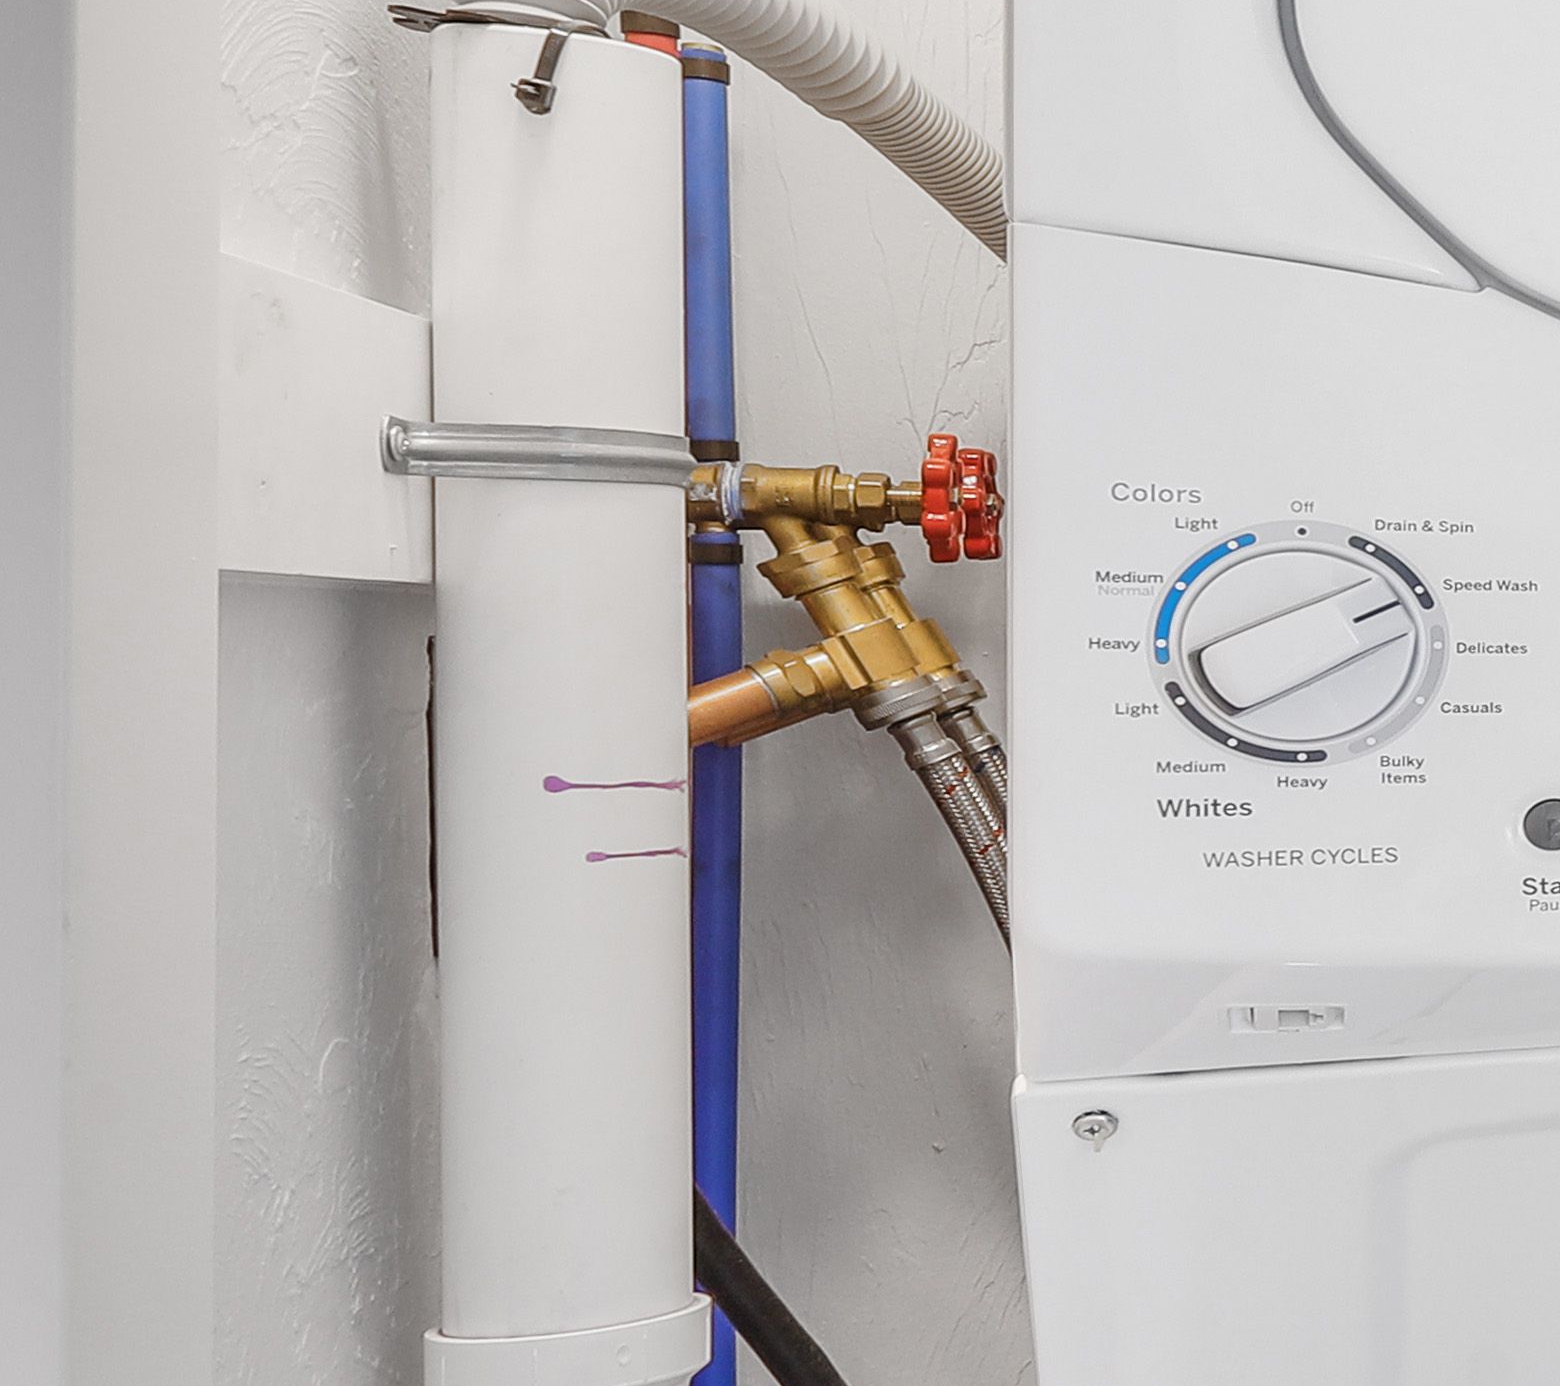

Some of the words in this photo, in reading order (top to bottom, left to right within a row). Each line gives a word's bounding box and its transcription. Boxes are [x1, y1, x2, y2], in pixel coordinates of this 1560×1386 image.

[1111, 482, 1202, 504] Colors
[1290, 501, 1315, 513] Off
[1174, 516, 1218, 533] Light
[1374, 519, 1416, 533] Drain
[1422, 521, 1433, 533] &
[1439, 521, 1474, 535] Spin
[1095, 571, 1164, 584] Medium
[1098, 586, 1155, 597] Normal
[1443, 579, 1493, 594] Speed
[1496, 580, 1538, 593] Wash
[1088, 638, 1140, 653] Heavy
[1456, 642, 1528, 656] Delicates
[1115, 703, 1159, 718] Light
[1440, 702, 1503, 714] Casuals
[1156, 760, 1226, 774] Medium
[1380, 756, 1425, 771] Bulky
[1277, 776, 1328, 791] Heavy
[1381, 772, 1426, 785] Items
[1157, 798, 1253, 818] Whites
[1203, 850, 1304, 869] WASHER
[1311, 847, 1399, 866] CYCLES
